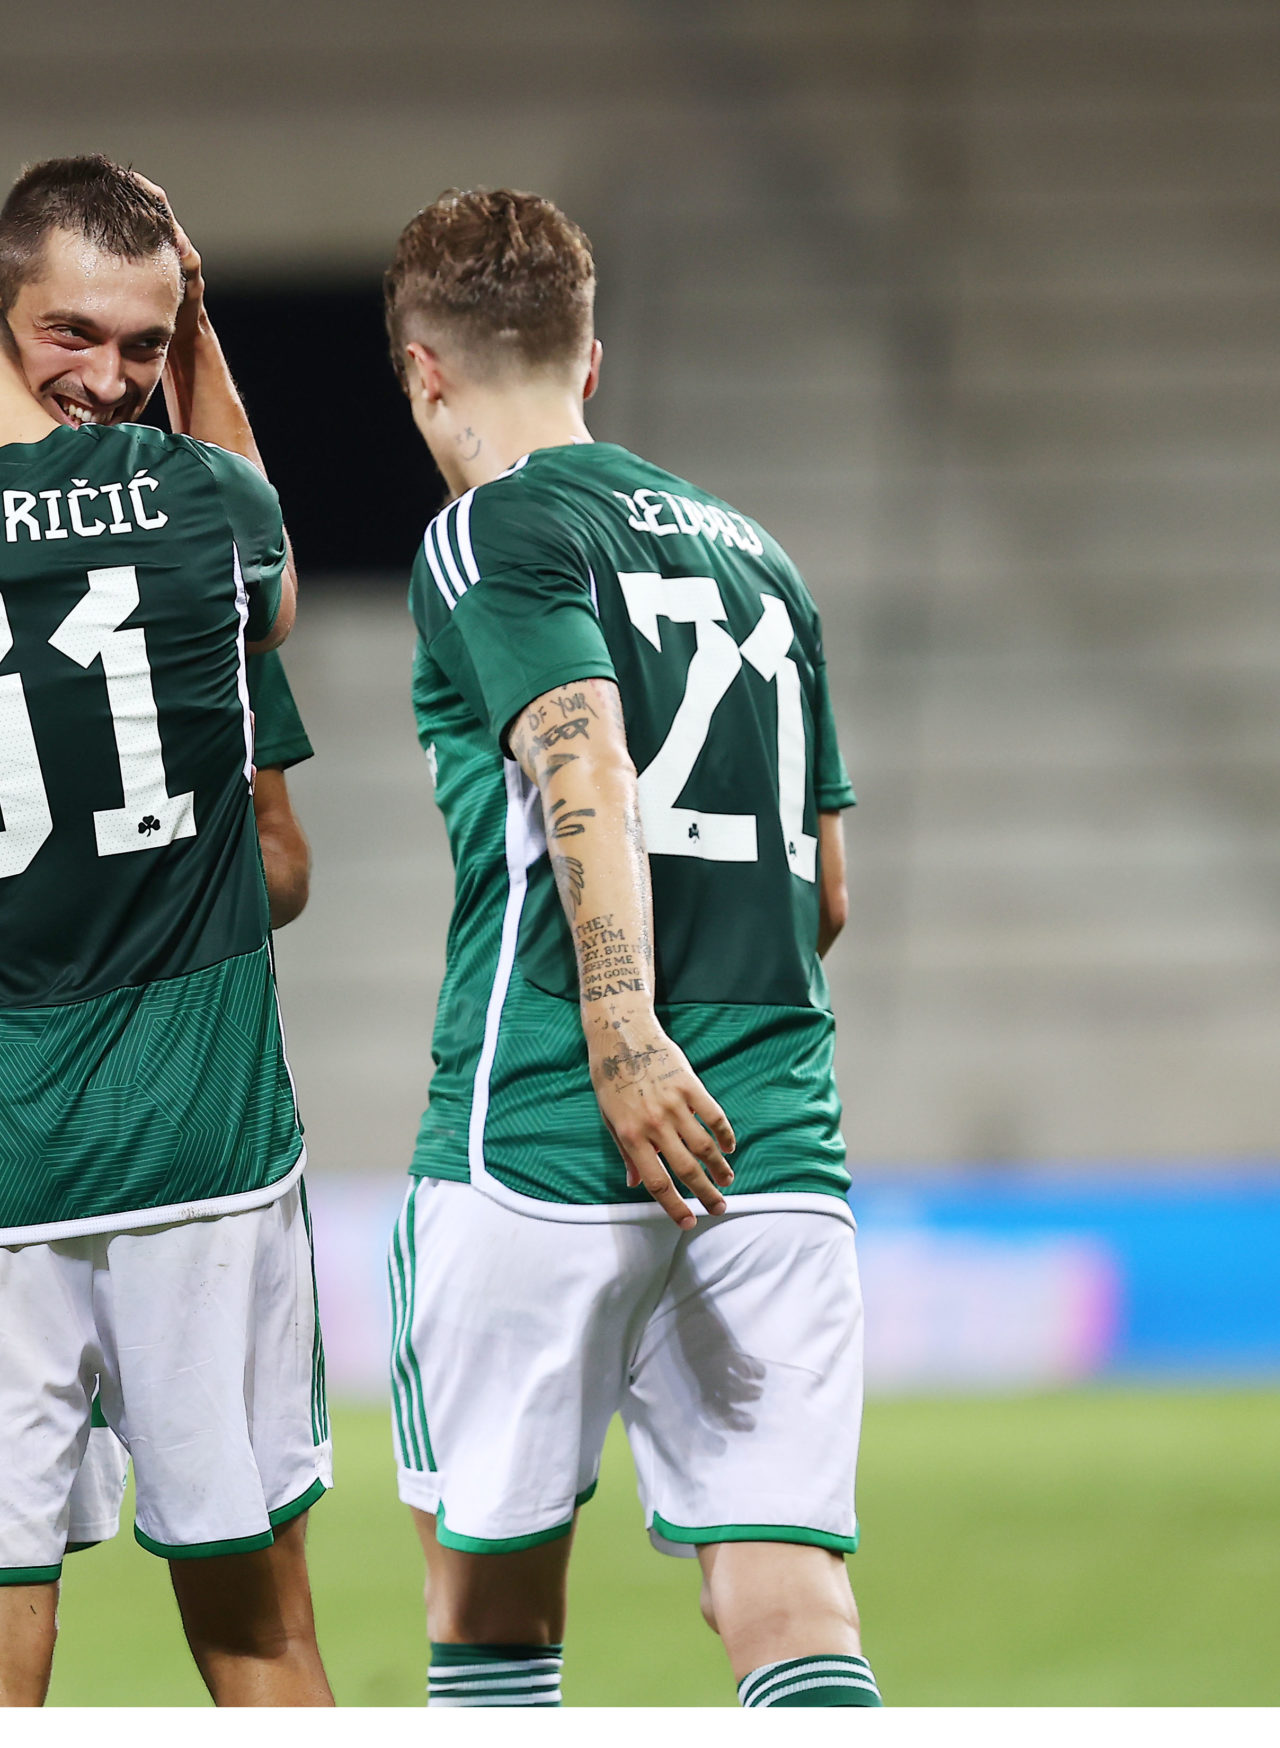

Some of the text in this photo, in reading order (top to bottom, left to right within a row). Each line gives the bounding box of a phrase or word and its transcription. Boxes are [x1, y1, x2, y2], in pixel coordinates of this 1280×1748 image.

[617, 571, 818, 884] 21
[579, 933, 599, 952] AY
[582, 954, 634, 976] EEPS ME
[584, 972, 602, 985] OM
[582, 978, 646, 1003] NSANE
